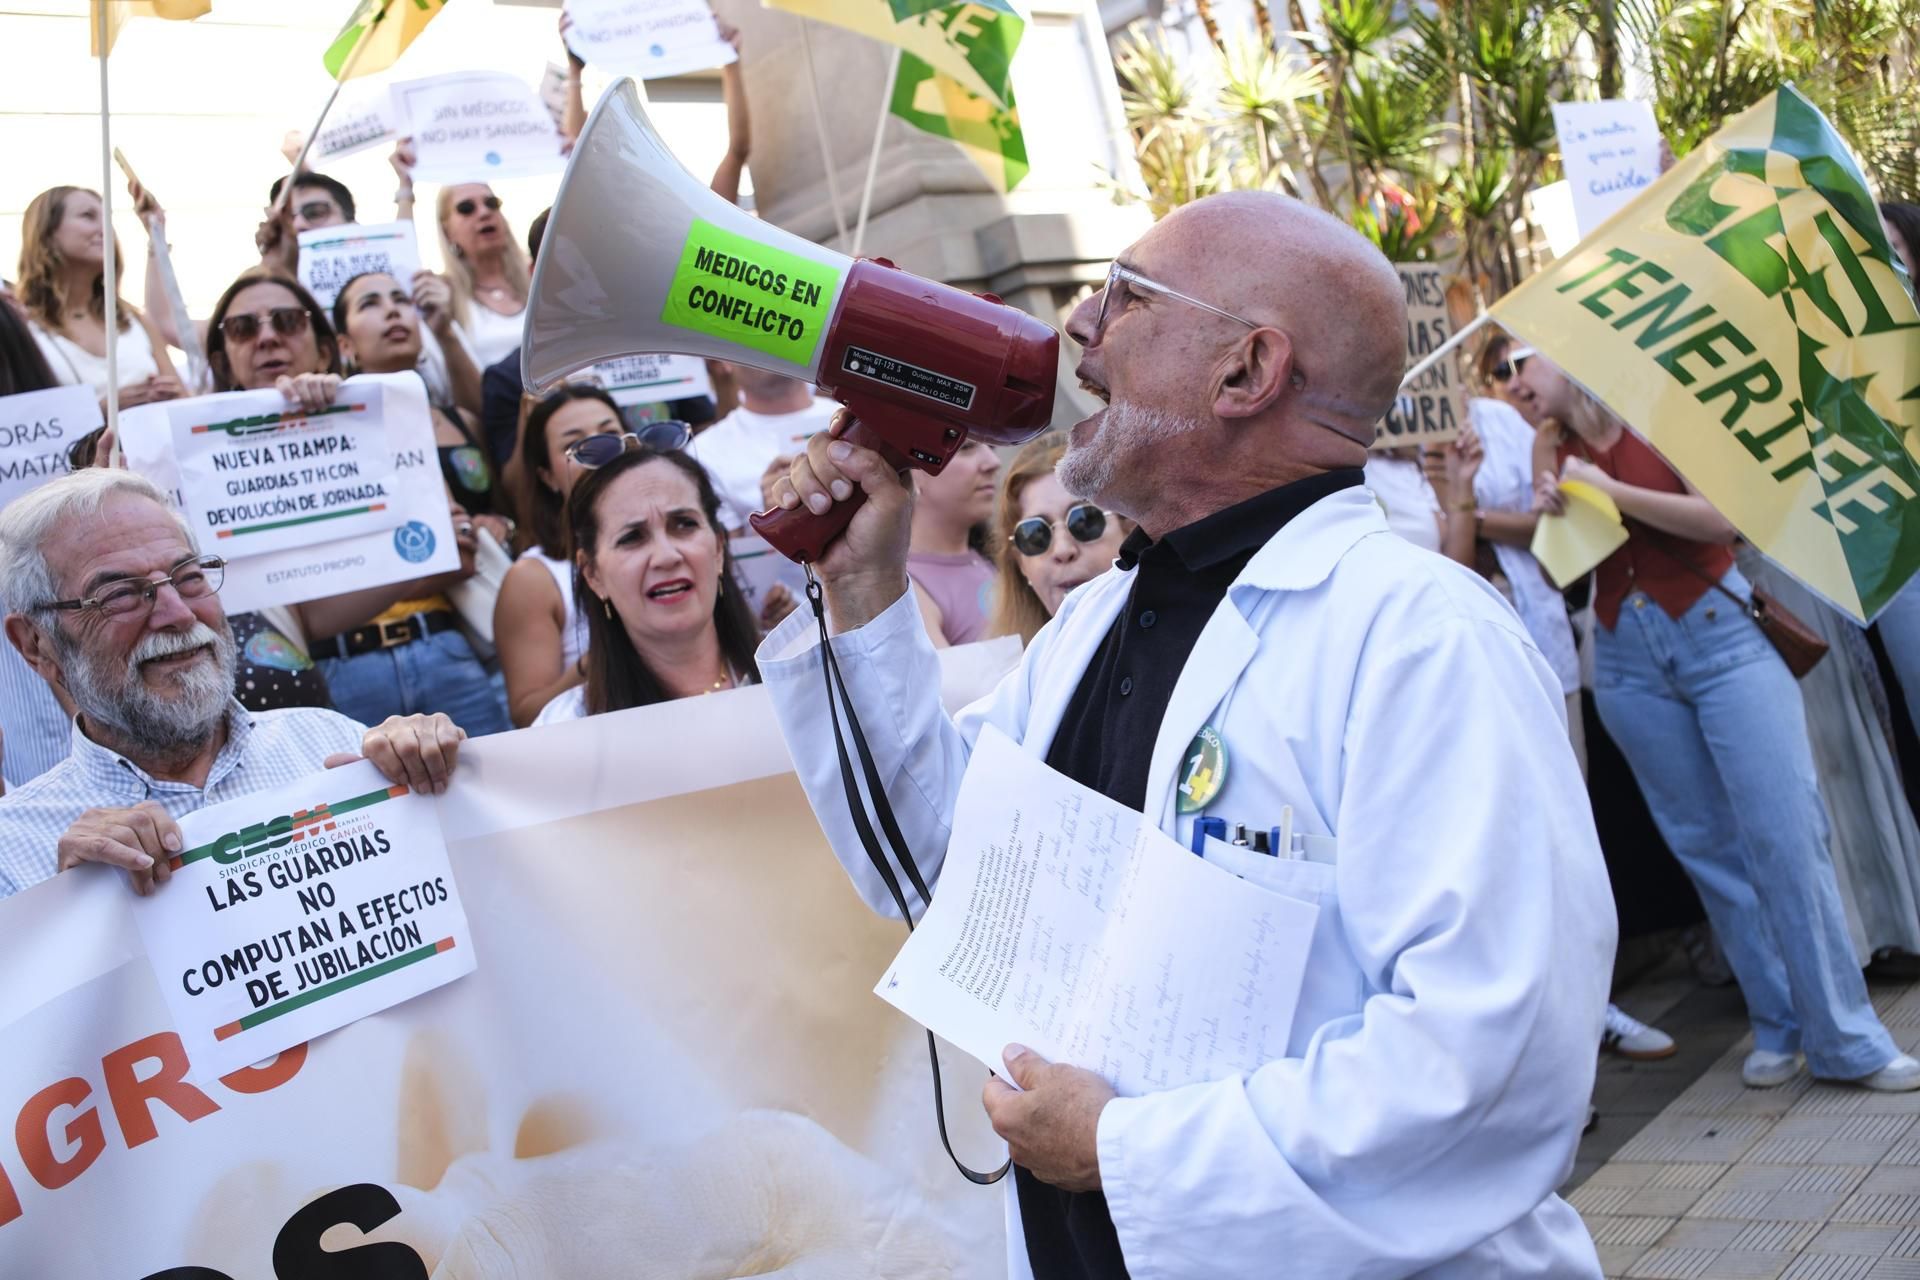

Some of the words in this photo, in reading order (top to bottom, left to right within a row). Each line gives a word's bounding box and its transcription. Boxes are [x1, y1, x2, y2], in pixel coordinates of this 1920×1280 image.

[421, 129, 448, 144] NO
[449, 127, 482, 142] HAY
[694, 246, 788, 296] MEDICOS
[790, 279, 822, 307] EN
[688, 285, 804, 341] CONFLICTO
[911, 370, 934, 383] Output:
[936, 378, 952, 388] MAX
[953, 383, 970, 393] 25W
[1555, 247, 1917, 536] TENERIFE
[1377, 395, 1456, 437] GURA
[213, 447, 275, 472] NUEVA
[277, 435, 356, 462] TRAMPA:
[395, 449, 425, 471] AN
[226, 471, 298, 496] GUARDIAS
[328, 461, 360, 479] CON
[207, 495, 297, 526] DEVOLUCIÓN
[300, 494, 319, 511] DE
[266, 564, 322, 585] ESTATUTO
[323, 555, 366, 573] PROPIO
[219, 852, 280, 879] SINDICATO
[284, 836, 326, 857] MÉDICO
[330, 821, 375, 843] CANARIO
[1008, 844, 1013, 855] en
[1009, 835, 1015, 843] la
[206, 871, 263, 913] LAS
[267, 828, 391, 890] GUARDIAS
[1020, 888, 1031, 920] sanidad
[1031, 859, 1038, 870] en
[297, 882, 336, 916] NO
[994, 873, 1007, 909] medicina
[182, 917, 334, 997] COMPUTAN
[338, 911, 358, 939] A
[356, 877, 448, 931] EFECTOS
[964, 942, 981, 974] sanidad
[976, 931, 984, 942] no
[999, 959, 1005, 970] en
[1012, 896, 1020, 911] nos
[246, 971, 289, 1008] DE
[293, 917, 423, 992] JUBILACIÓN
